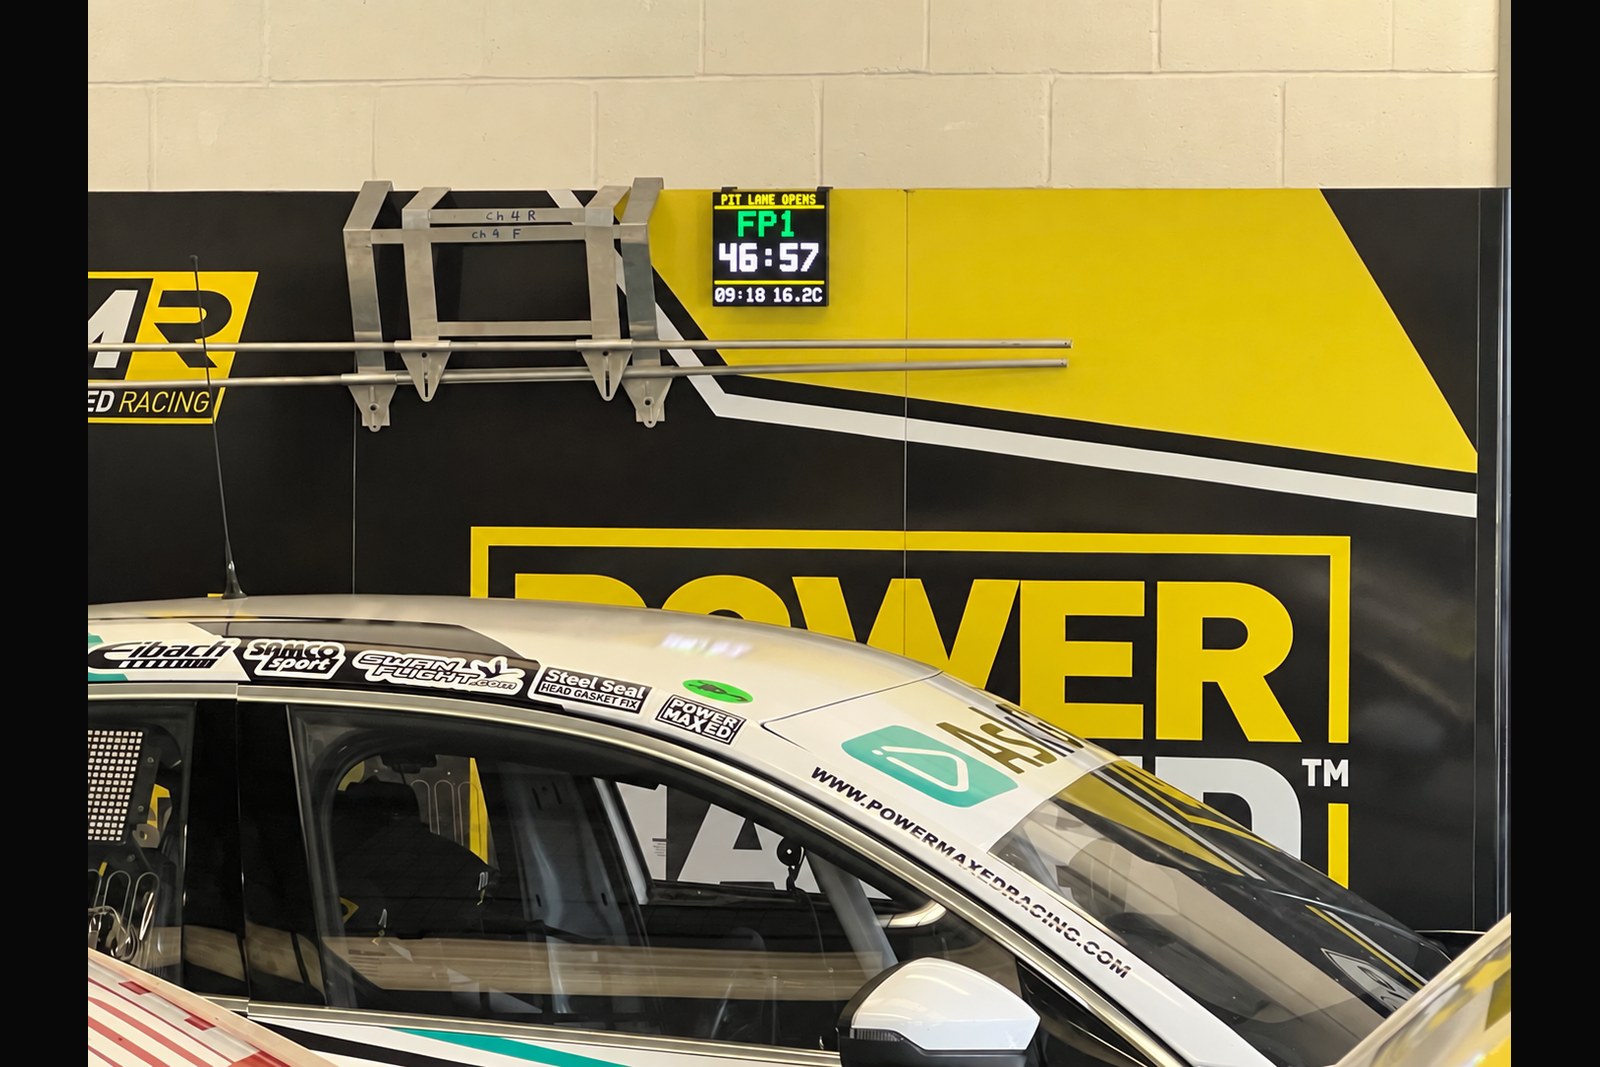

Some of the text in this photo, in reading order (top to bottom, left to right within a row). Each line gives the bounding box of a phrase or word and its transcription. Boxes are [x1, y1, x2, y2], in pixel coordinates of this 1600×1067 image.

[721, 194, 816, 205] PIT LANE OPENS
[511, 211, 520, 221] 4
[528, 210, 536, 221] R
[737, 210, 795, 237] FP1
[513, 229, 521, 239] F
[718, 242, 819, 272] 46:57
[714, 287, 823, 302] 09:18 16.2C
[118, 391, 210, 413] RACING
[89, 641, 232, 668] Eibach
[268, 658, 331, 673] sport
[358, 653, 456, 671] SWAN
[515, 573, 1302, 743] WER
[541, 683, 638, 709] HEAD GASKET FIX
[545, 669, 646, 698] Steel Seal
[662, 709, 735, 740] MAXED
[669, 699, 739, 732] POWER
[1301, 758, 1349, 787] TM
